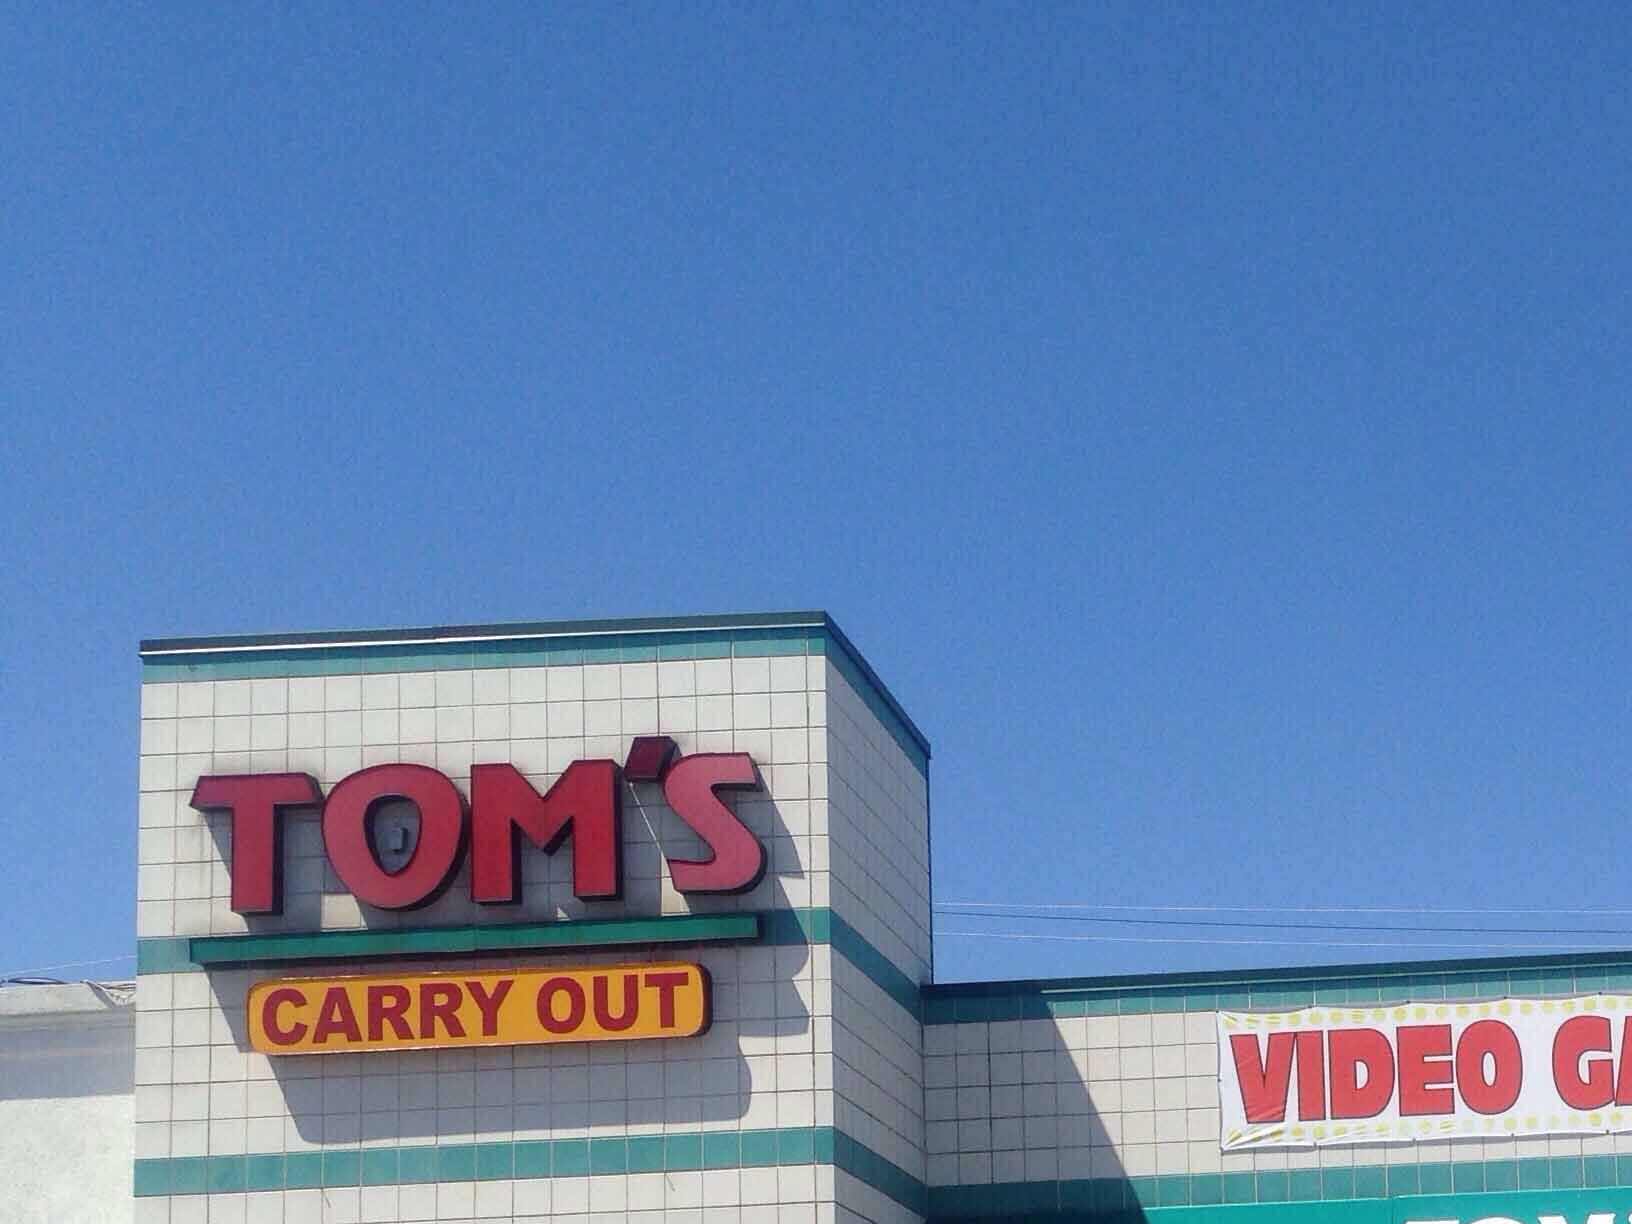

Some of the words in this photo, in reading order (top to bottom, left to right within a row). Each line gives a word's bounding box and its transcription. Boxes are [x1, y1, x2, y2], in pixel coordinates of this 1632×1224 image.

[190, 736, 766, 915] TOM'S
[261, 978, 513, 1047] CARRY
[537, 972, 690, 1032] OUT
[1230, 1020, 1523, 1124] VIDEO
